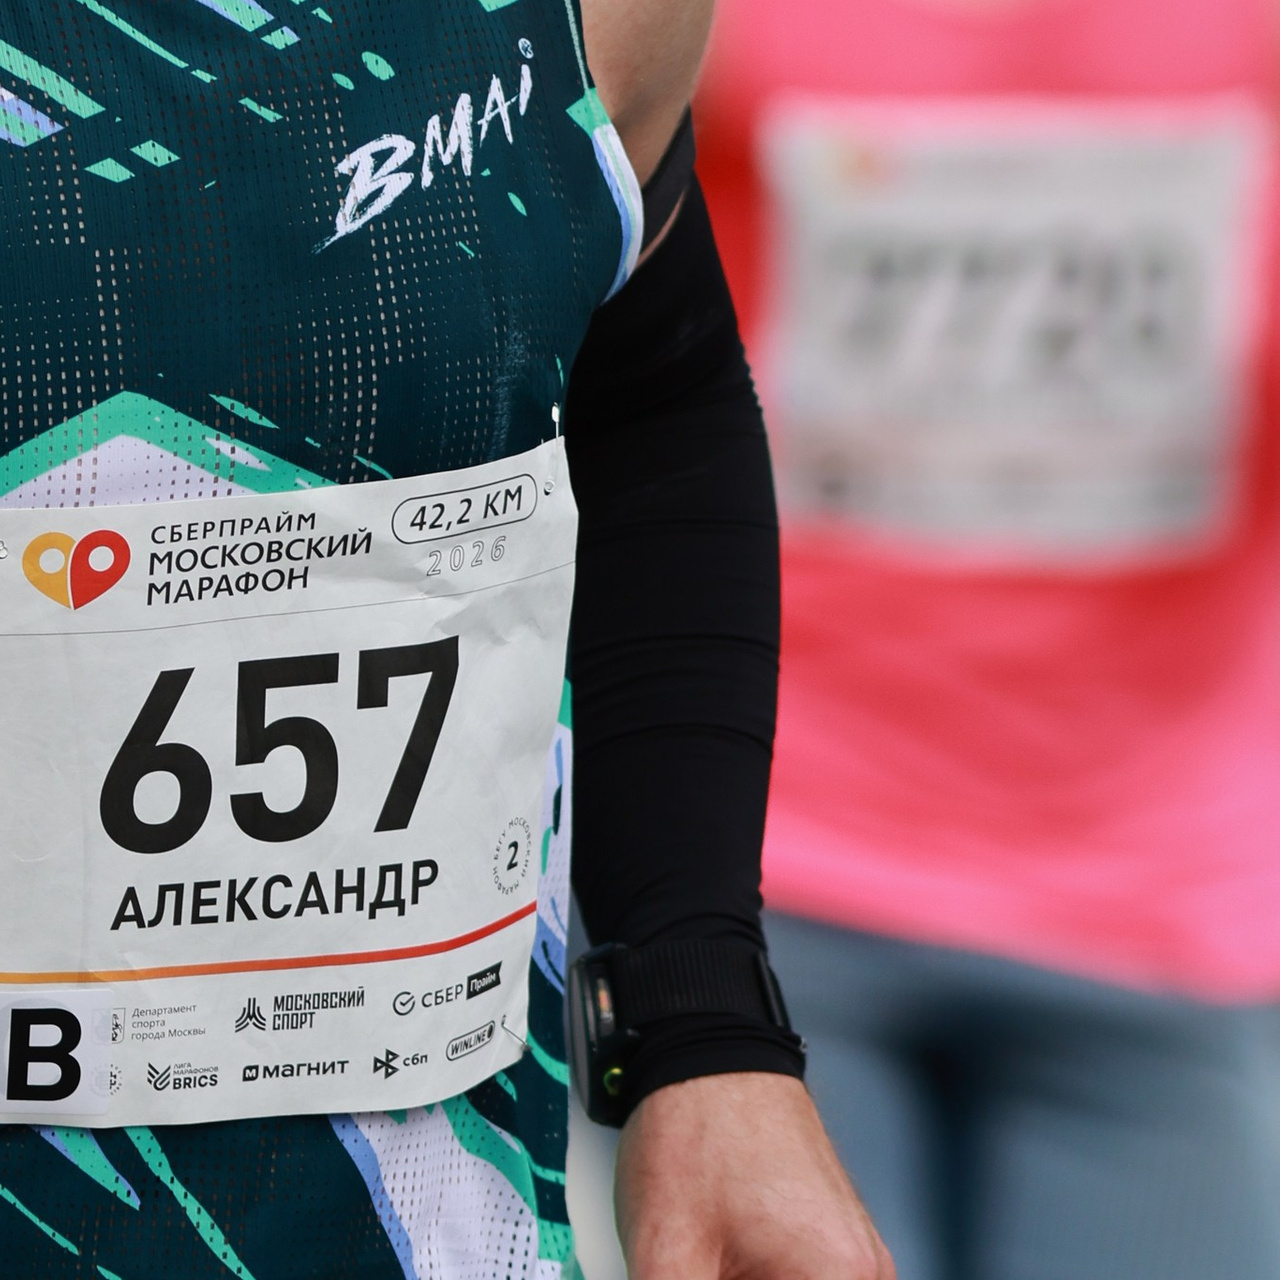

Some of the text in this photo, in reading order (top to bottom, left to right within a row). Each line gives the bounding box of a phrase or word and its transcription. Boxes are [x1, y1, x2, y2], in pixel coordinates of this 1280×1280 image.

[150, 511, 317, 545] СБЕРПРАЙМ
[409, 497, 474, 534] 42,2
[148, 527, 373, 576] МОСКОВСКИЙ
[425, 535, 507, 578] 2026
[146, 565, 310, 607] МАРАФОН
[98, 634, 460, 855] 657
[506, 840, 519, 872] 2
[109, 858, 440, 931] АЛЕКСАНДР
[272, 986, 366, 1013] МОСКОВСКИЙ
[421, 970, 498, 1008] СБЕР Прайм
[131, 1004, 198, 1018] Департамент
[131, 1019, 166, 1030] спорта
[271, 1012, 316, 1031] СПОРТ
[131, 1028, 207, 1042] города Москвы
[449, 1029, 488, 1056] WINLINE
[172, 1066, 219, 1076] МАРАФОНОВ
[173, 1062, 192, 1070] ЛИГА
[262, 1060, 350, 1079] магнит
[402, 1053, 429, 1067] сбп
[172, 1074, 219, 1090] BRICS
